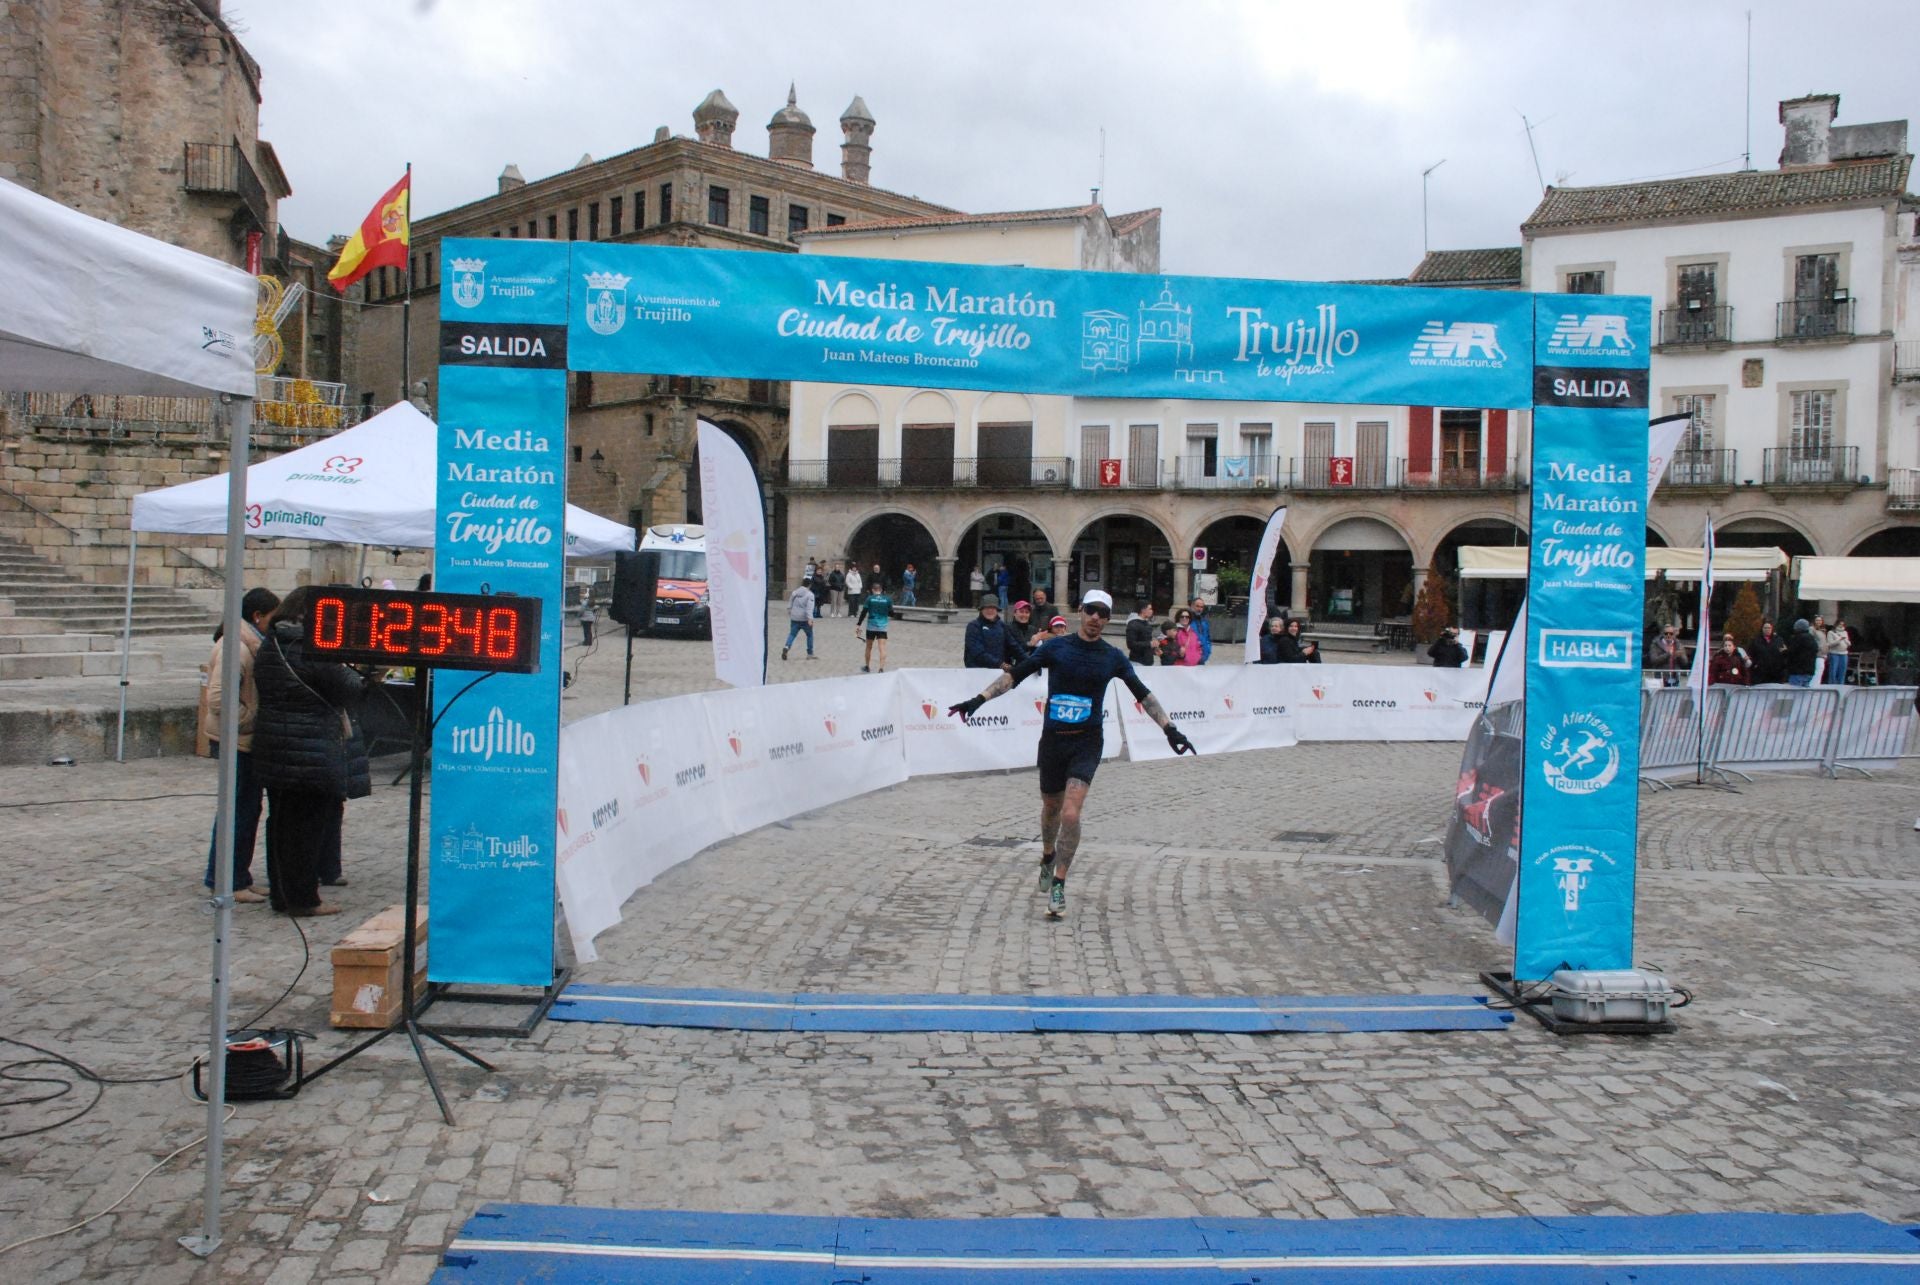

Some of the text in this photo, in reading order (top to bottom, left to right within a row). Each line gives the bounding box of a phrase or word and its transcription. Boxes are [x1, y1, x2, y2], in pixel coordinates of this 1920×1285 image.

[490, 285, 535, 299] Trujillo
[634, 294, 721, 308] Ayuntamiento de
[814, 279, 1057, 318] Media Maratón
[633, 306, 692, 324] Trujillo
[776, 308, 1032, 358] Ciudad de Trujillo
[1226, 304, 1360, 368] Trujillo
[460, 334, 547, 358] SALIDA
[1547, 346, 1632, 357] www.musicrun.es
[822, 348, 979, 368] Juan Mateos Broncano
[1257, 356, 1272, 377] te
[1408, 357, 1503, 369] www.musicrun.es
[1553, 378, 1631, 398] SALIDA
[454, 428, 549, 452] Media
[286, 473, 363, 485] primaflor
[447, 462, 555, 485] Maratón
[1547, 462, 1633, 484] Media
[461, 492, 539, 510] Ciudad de
[1542, 493, 1638, 513] Maratón
[263, 509, 327, 527] primaflor
[1553, 519, 1623, 537] Ciudad de
[446, 511, 552, 554] Trujillo
[450, 557, 549, 569] Juan Mateos Broncano
[1540, 537, 1635, 577] Trujillo
[313, 598, 518, 658] 01:23:48
[1552, 641, 1618, 658] HABLA
[1057, 706, 1083, 720] 547
[452, 706, 536, 762] trujillo
[1540, 711, 1614, 750] Club Atletismo
[1548, 775, 1602, 790] TRUJILLO
[485, 834, 539, 859] Trujillo
